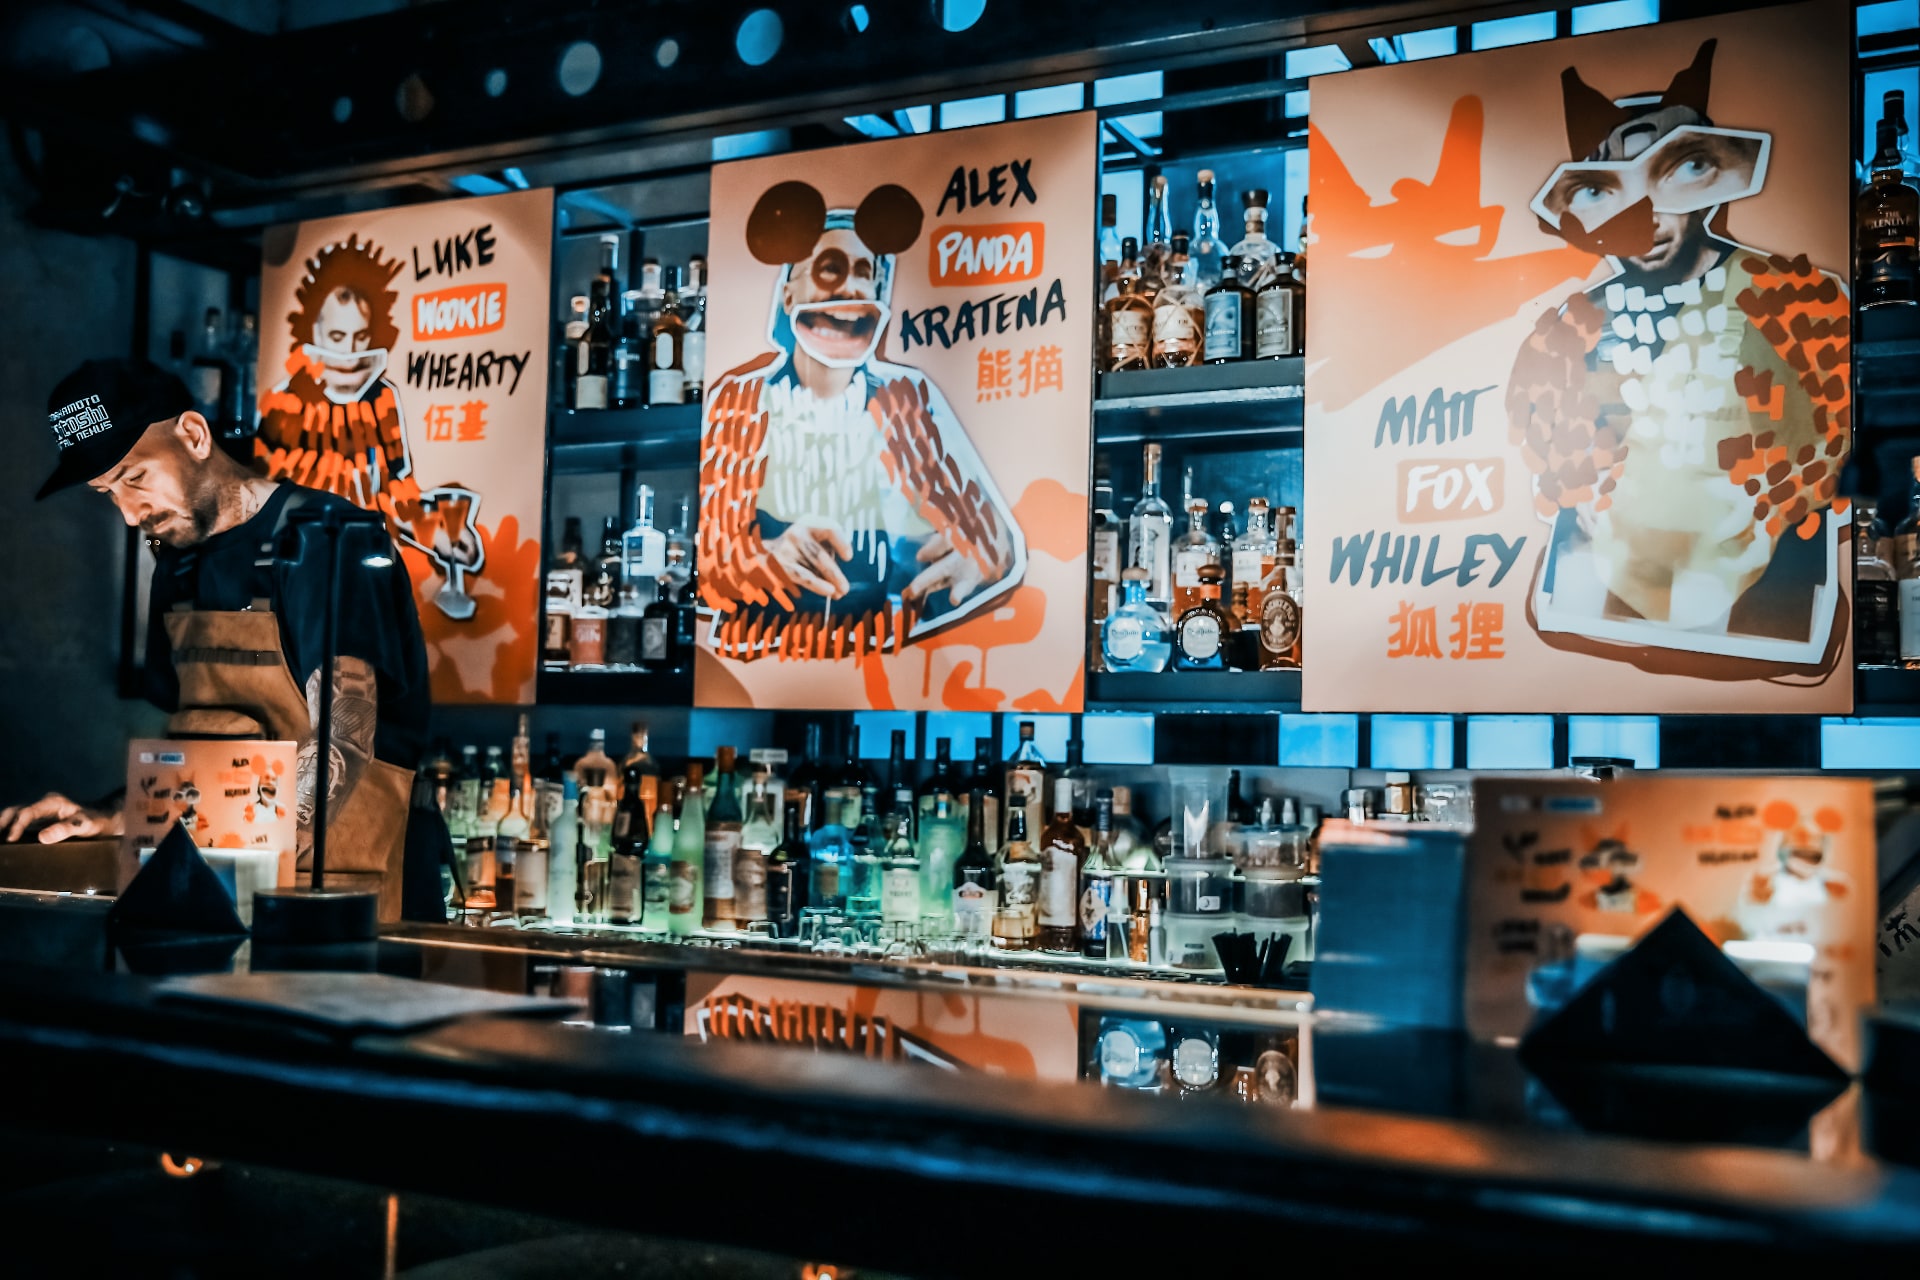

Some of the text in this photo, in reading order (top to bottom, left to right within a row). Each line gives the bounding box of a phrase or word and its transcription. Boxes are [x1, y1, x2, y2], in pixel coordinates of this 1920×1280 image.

[936, 158, 1037, 217] ALEX
[413, 224, 497, 282] LUKE
[937, 231, 1033, 278] PANDA
[417, 291, 502, 335] WOOKIE
[900, 278, 1066, 352] KRATENA
[407, 350, 531, 396] WHEARTY
[976, 344, 1064, 403] 熊猫
[1374, 385, 1499, 448] MATT
[1406, 463, 1495, 512] FOX
[1329, 529, 1528, 589] WHILEY
[1387, 600, 1506, 660] 狐狸
